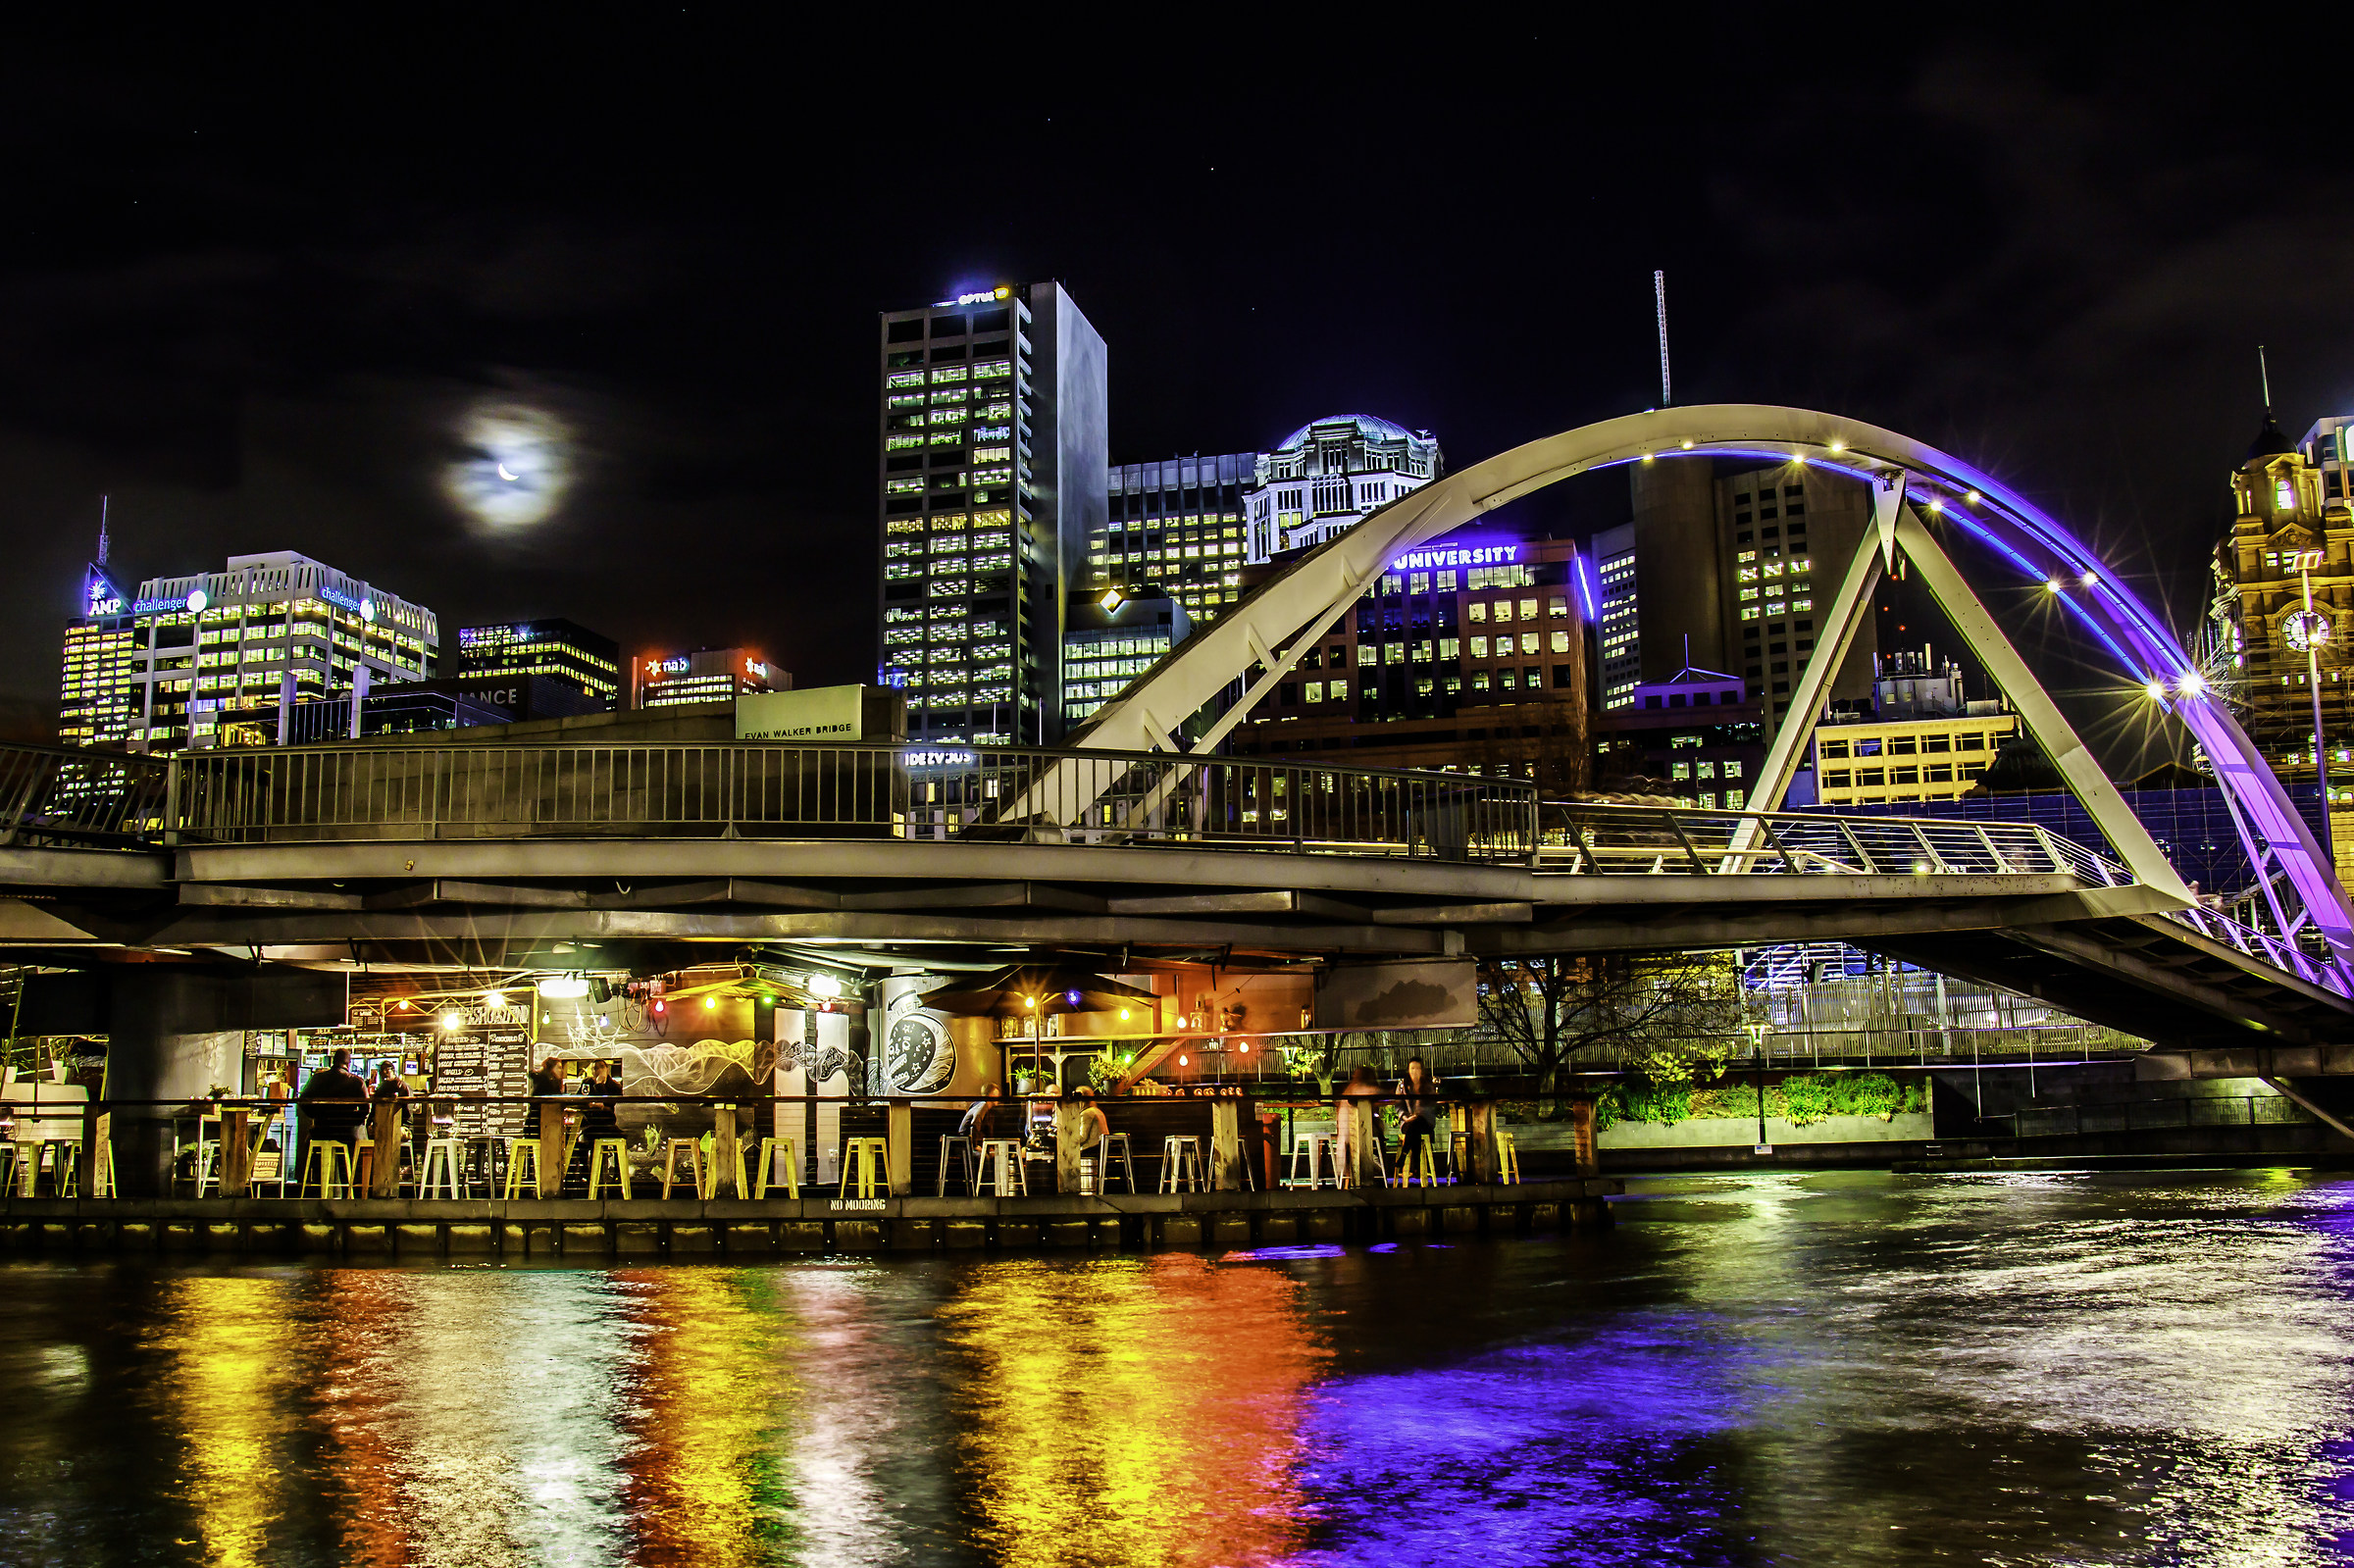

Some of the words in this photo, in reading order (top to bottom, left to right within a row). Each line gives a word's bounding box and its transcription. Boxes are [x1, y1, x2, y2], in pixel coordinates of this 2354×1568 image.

[1394, 546, 1517, 570] UNIVERSITY
[133, 597, 186, 612] challenger
[321, 586, 361, 612] challenger
[88, 598, 122, 617] AMP
[662, 658, 688, 672] nab
[774, 727, 811, 737] WALKER
[816, 724, 851, 734] BRIDGE
[830, 1199, 844, 1211] NO
[844, 1198, 886, 1211] MOORING
